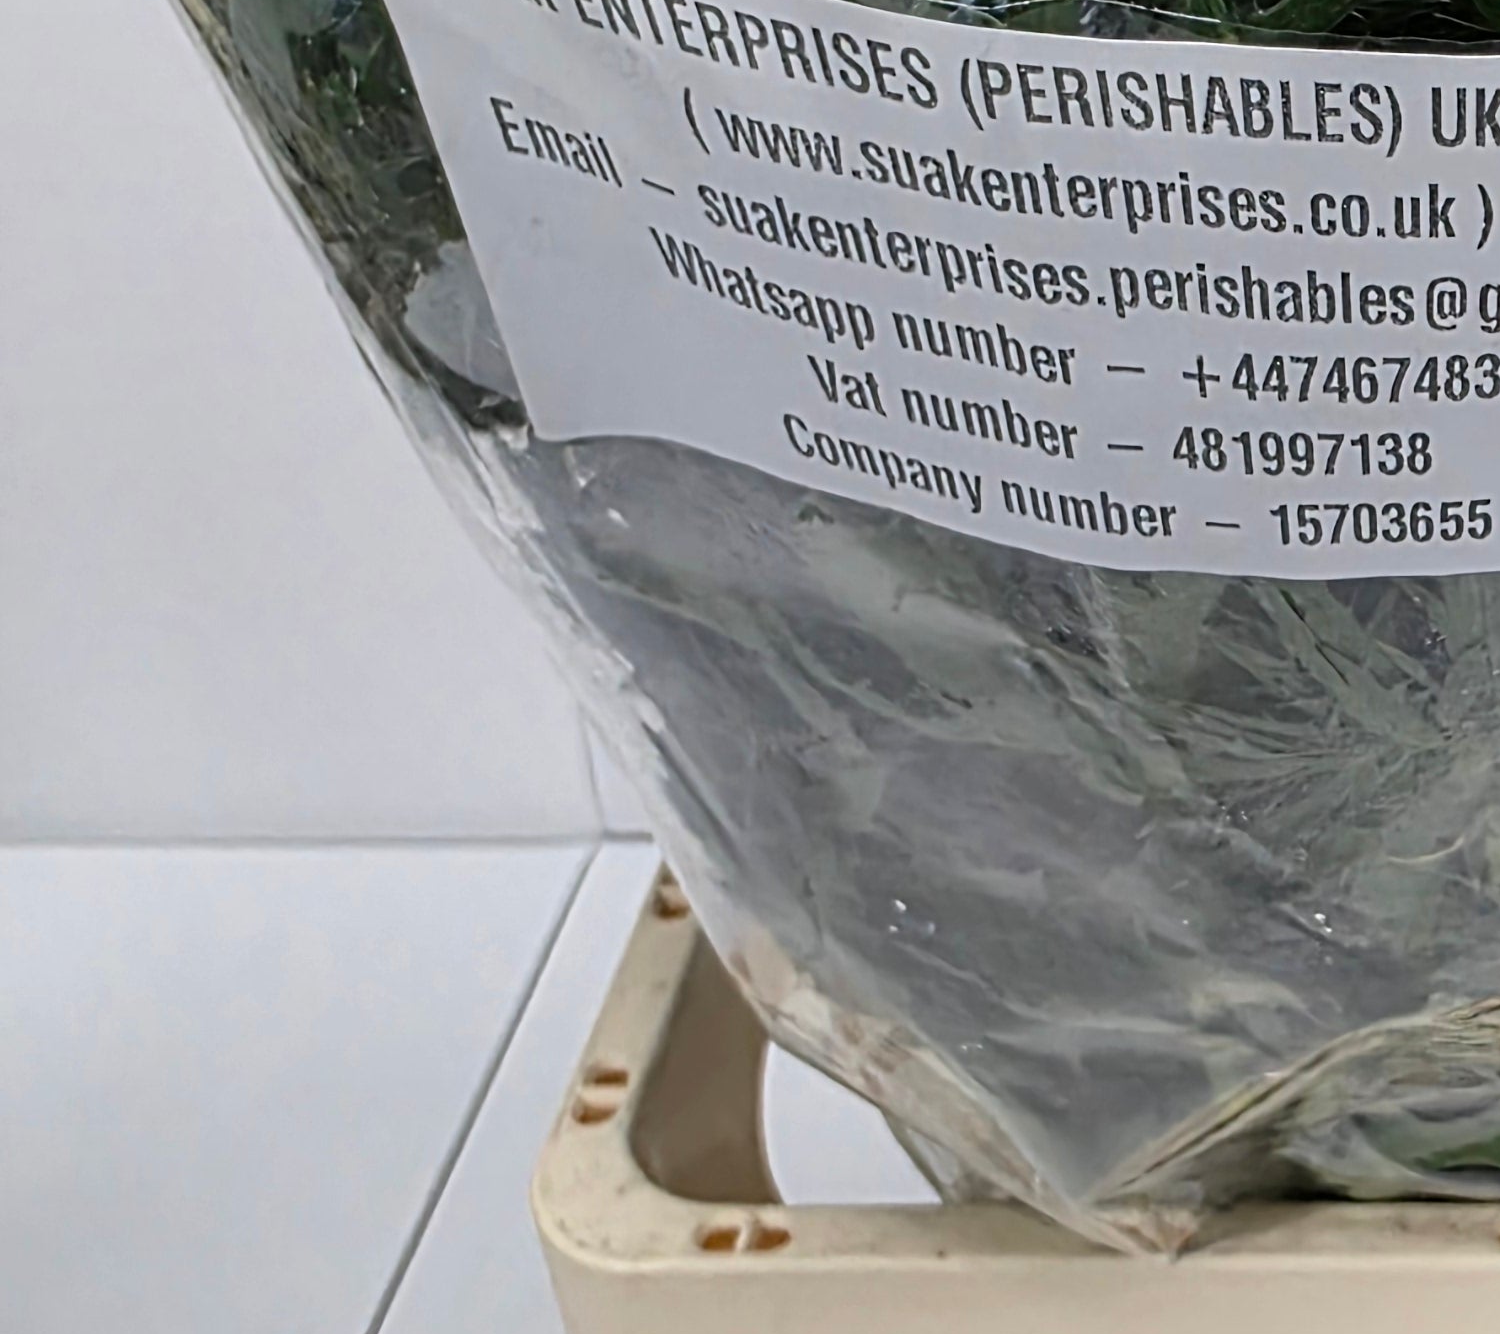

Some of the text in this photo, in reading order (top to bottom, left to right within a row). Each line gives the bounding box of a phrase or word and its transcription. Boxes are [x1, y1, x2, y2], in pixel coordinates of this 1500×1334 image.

[490, 97, 622, 188] Email
[961, 58, 1403, 157] (PERISHABLES)
[716, 106, 1456, 239] www.suakenterprises.co.uk
[648, 226, 874, 350] Whatsapp
[892, 309, 1076, 386] number
[807, 356, 888, 417] Vat
[902, 389, 1078, 460] number
[1173, 426, 1432, 476] 481997138
[783, 413, 983, 514] Company
[1001, 476, 1176, 537] number
[1270, 499, 1493, 546] 15703655
